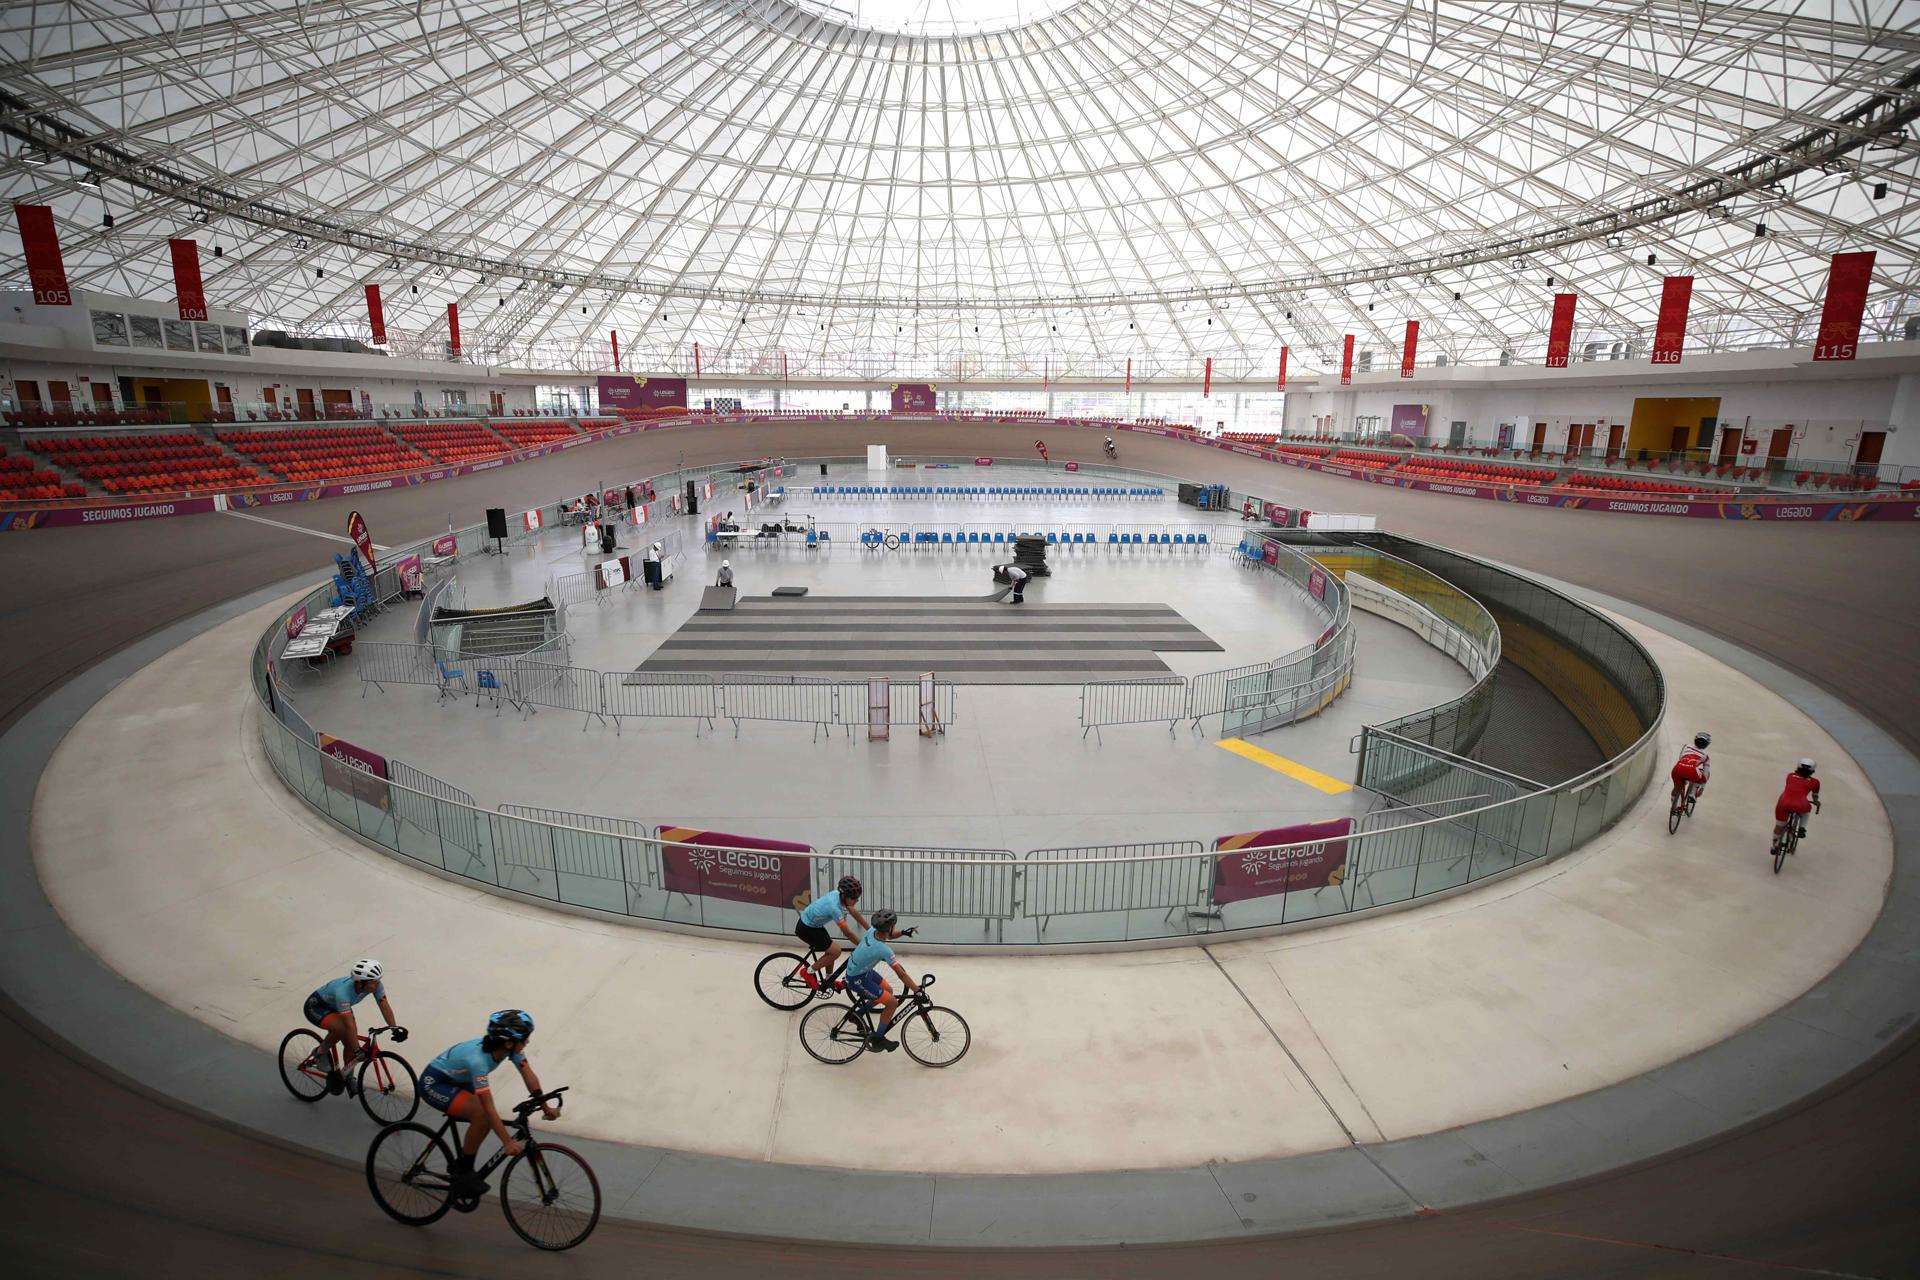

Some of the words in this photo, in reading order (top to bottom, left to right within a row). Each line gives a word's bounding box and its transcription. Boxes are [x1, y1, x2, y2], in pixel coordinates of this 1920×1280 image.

[37, 290, 69, 303] 105
[181, 309, 206, 320] 104
[1654, 351, 1680, 362] 116
[1817, 344, 1853, 359] 115
[1547, 356, 1567, 367] 117
[343, 484, 371, 494] SEGUIMOS
[370, 480, 393, 490] JUGANDO
[82, 508, 133, 522] SEGUIMOS
[133, 504, 176, 518] JUGANDO
[1609, 501, 1649, 513] SEGUIMOS
[1649, 504, 1689, 514] JUGANDO
[718, 865, 753, 878] Seguimos
[892, 1001, 917, 1024] LOOK
